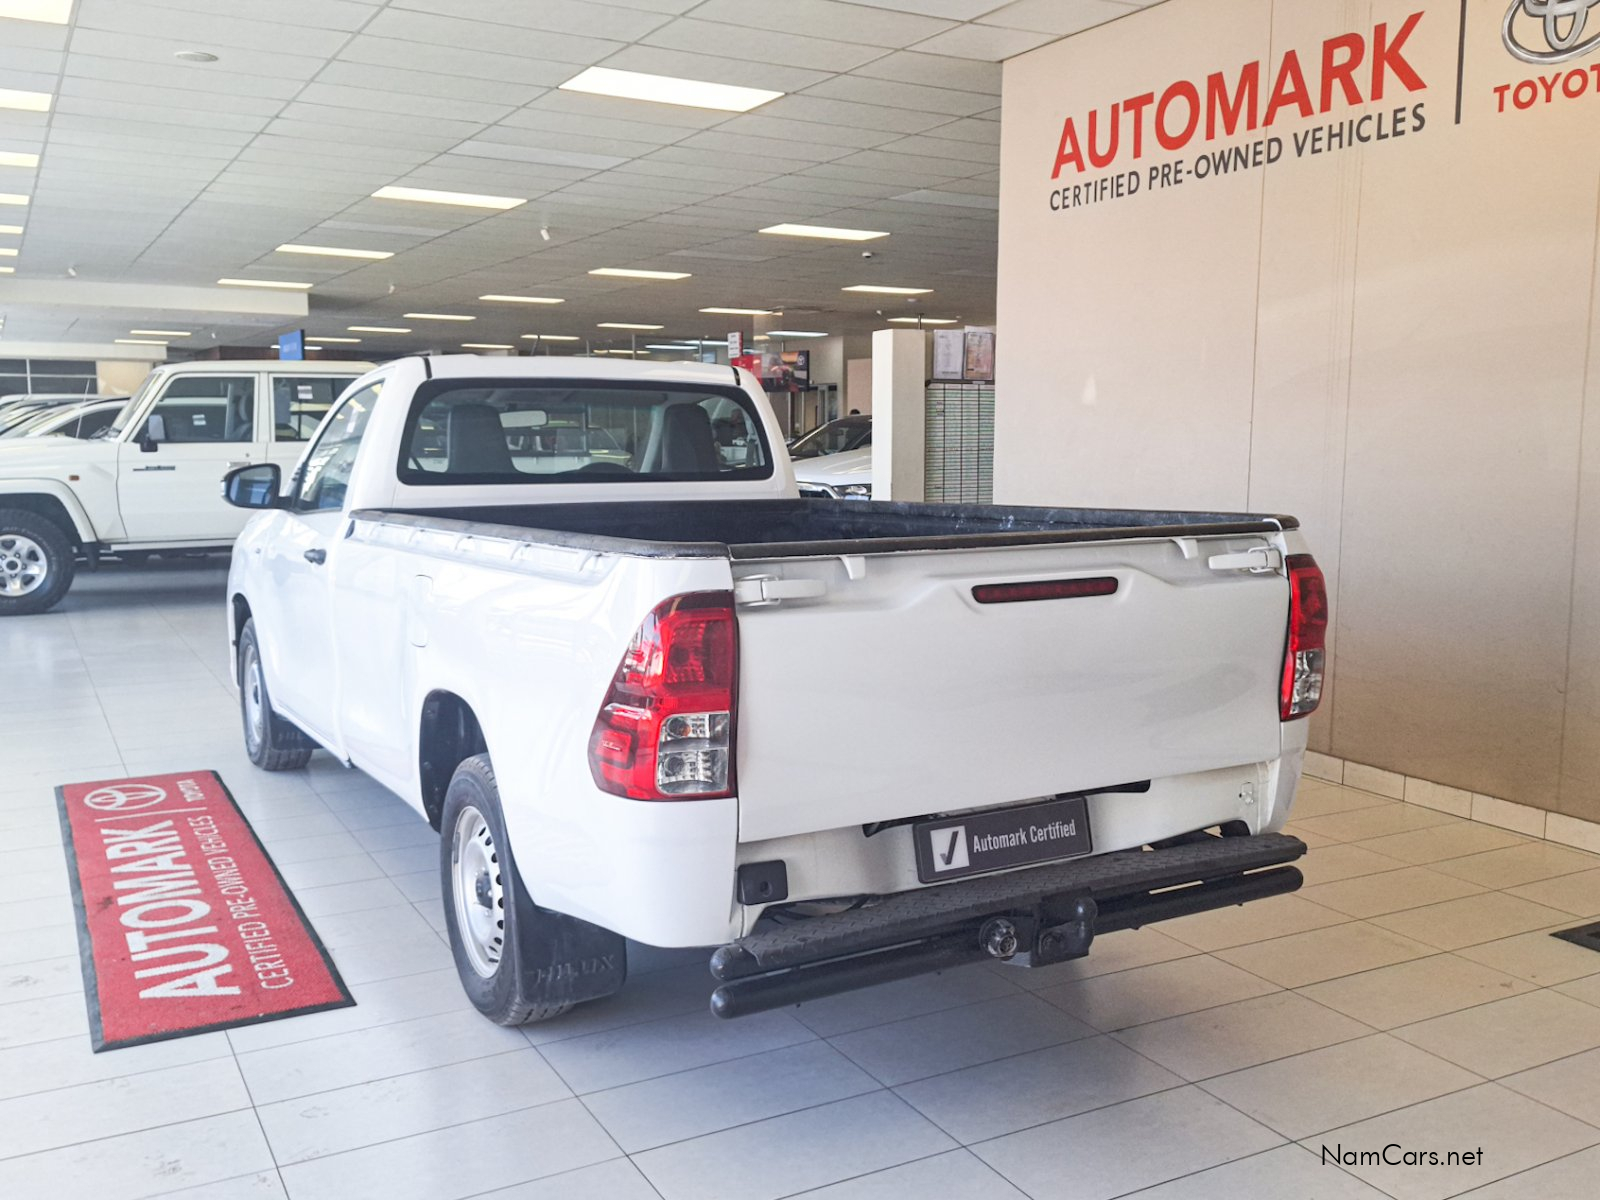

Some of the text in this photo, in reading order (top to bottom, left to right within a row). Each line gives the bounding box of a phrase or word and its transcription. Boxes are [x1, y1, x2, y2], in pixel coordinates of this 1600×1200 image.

[1049, 103, 1426, 211] CERTIFIED PRE-OWNED VEHICLES
[1051, 11, 1427, 179] AUTOMARK
[101, 820, 242, 999] AUTOMARK
[187, 815, 294, 989] CERTIFIED PRE-OWNED VEHICLES
[973, 819, 1076, 853] Automark Certified
